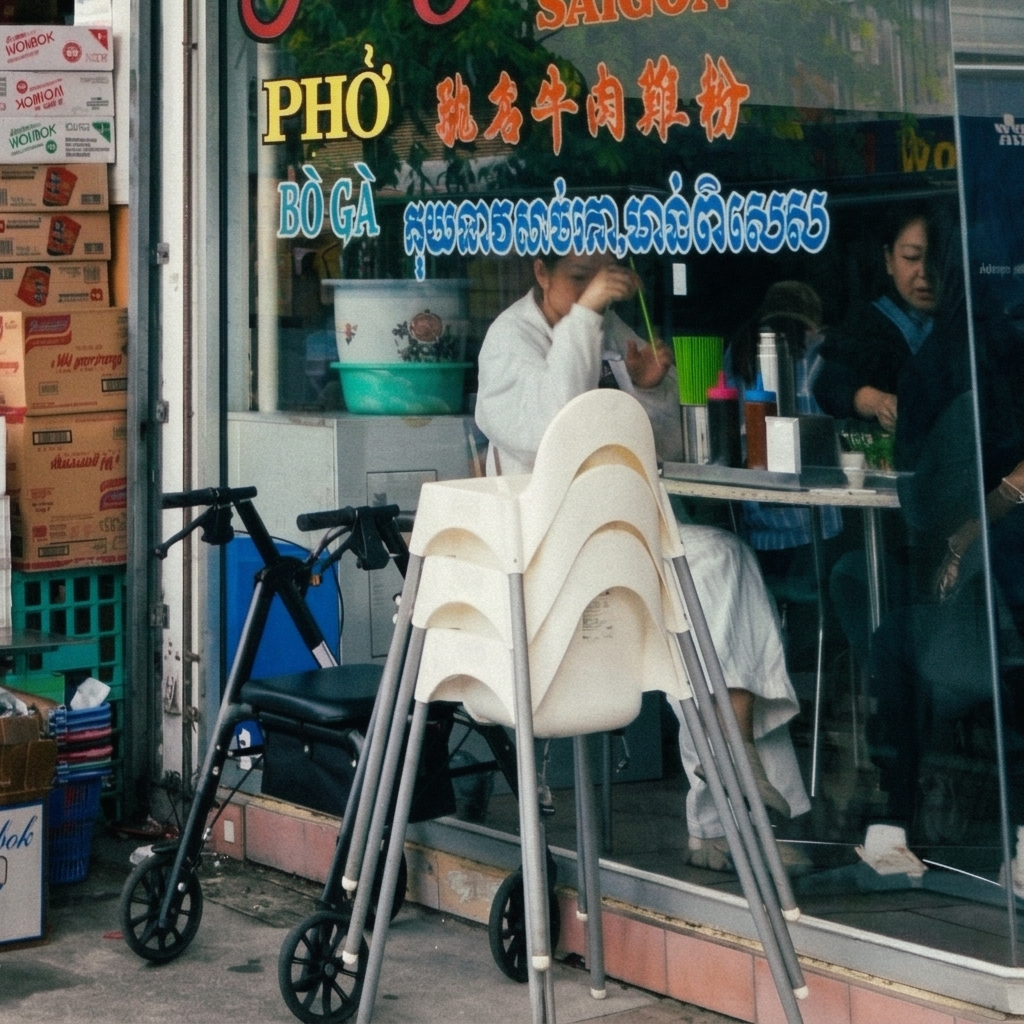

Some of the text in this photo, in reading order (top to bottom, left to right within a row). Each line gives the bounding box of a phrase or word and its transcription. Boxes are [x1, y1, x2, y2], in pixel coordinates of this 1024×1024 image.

[262, 44, 392, 145] PHỞ
[277, 161, 380, 249] BÒ GÀ
